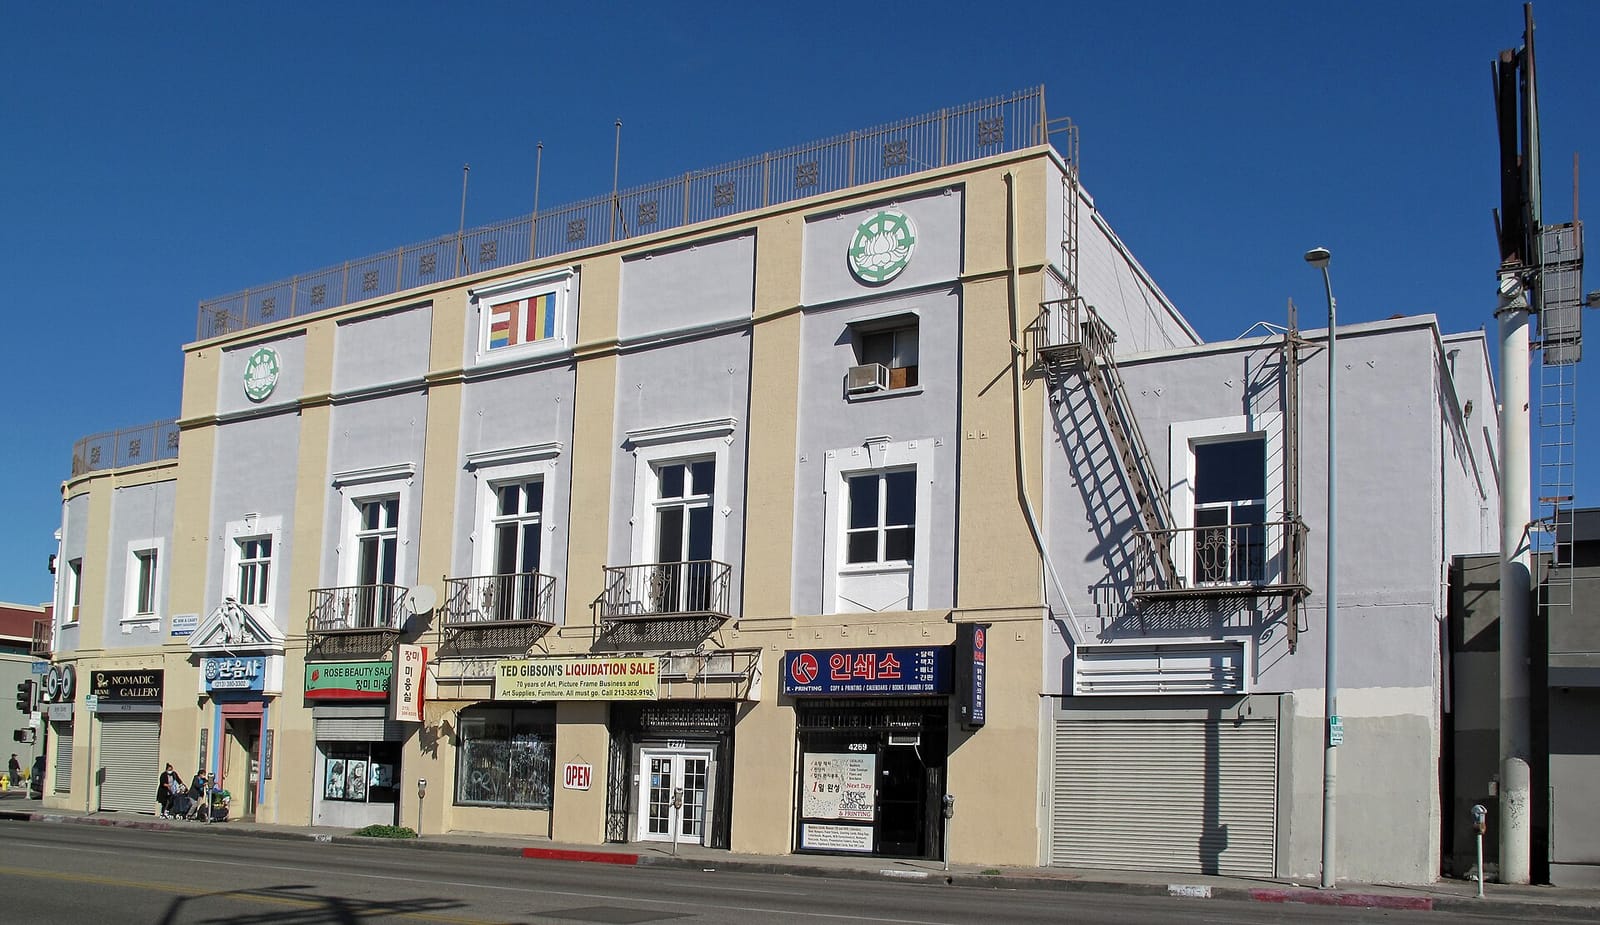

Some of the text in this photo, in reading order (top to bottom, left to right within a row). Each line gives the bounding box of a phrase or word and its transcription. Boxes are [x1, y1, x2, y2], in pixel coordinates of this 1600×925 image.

[405, 650, 419, 662] 장미
[218, 659, 259, 678] 관음사
[324, 667, 393, 677] ROSE BEAUTY SALO
[501, 662, 655, 677] TED GIBSON'S LIQUIDATION SALE
[829, 652, 901, 680] 인쇄소
[112, 675, 154, 685] NOMADIC
[355, 679, 371, 691] 장미
[403, 666, 413, 703] 미용실
[120, 687, 160, 697] GALLERY
[848, 743, 868, 751] 4269
[566, 765, 591, 787] OPEN
